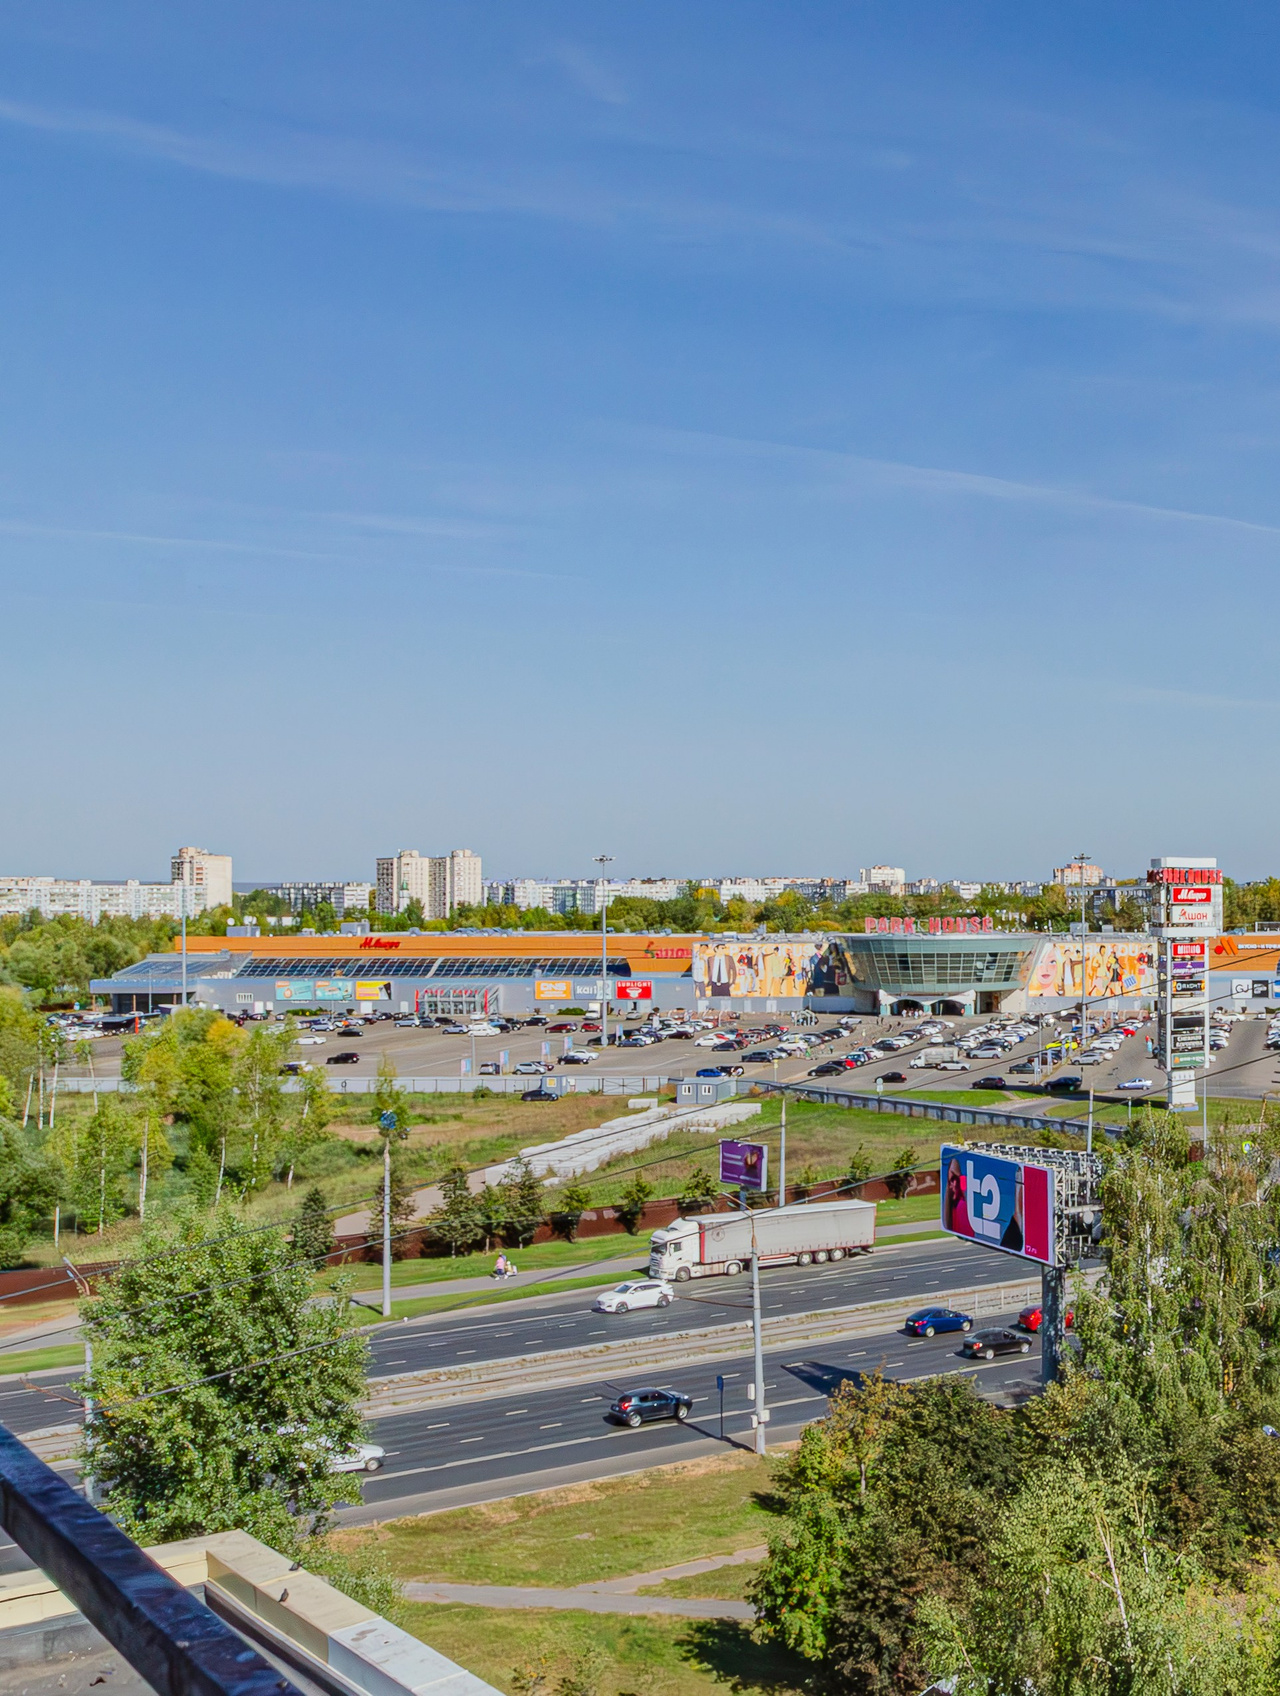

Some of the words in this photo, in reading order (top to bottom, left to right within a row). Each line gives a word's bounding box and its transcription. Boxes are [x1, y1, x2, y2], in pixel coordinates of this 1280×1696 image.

[865, 916, 915, 934] PARK
[929, 916, 994, 934] HOUSE
[540, 982, 567, 991] DNS
